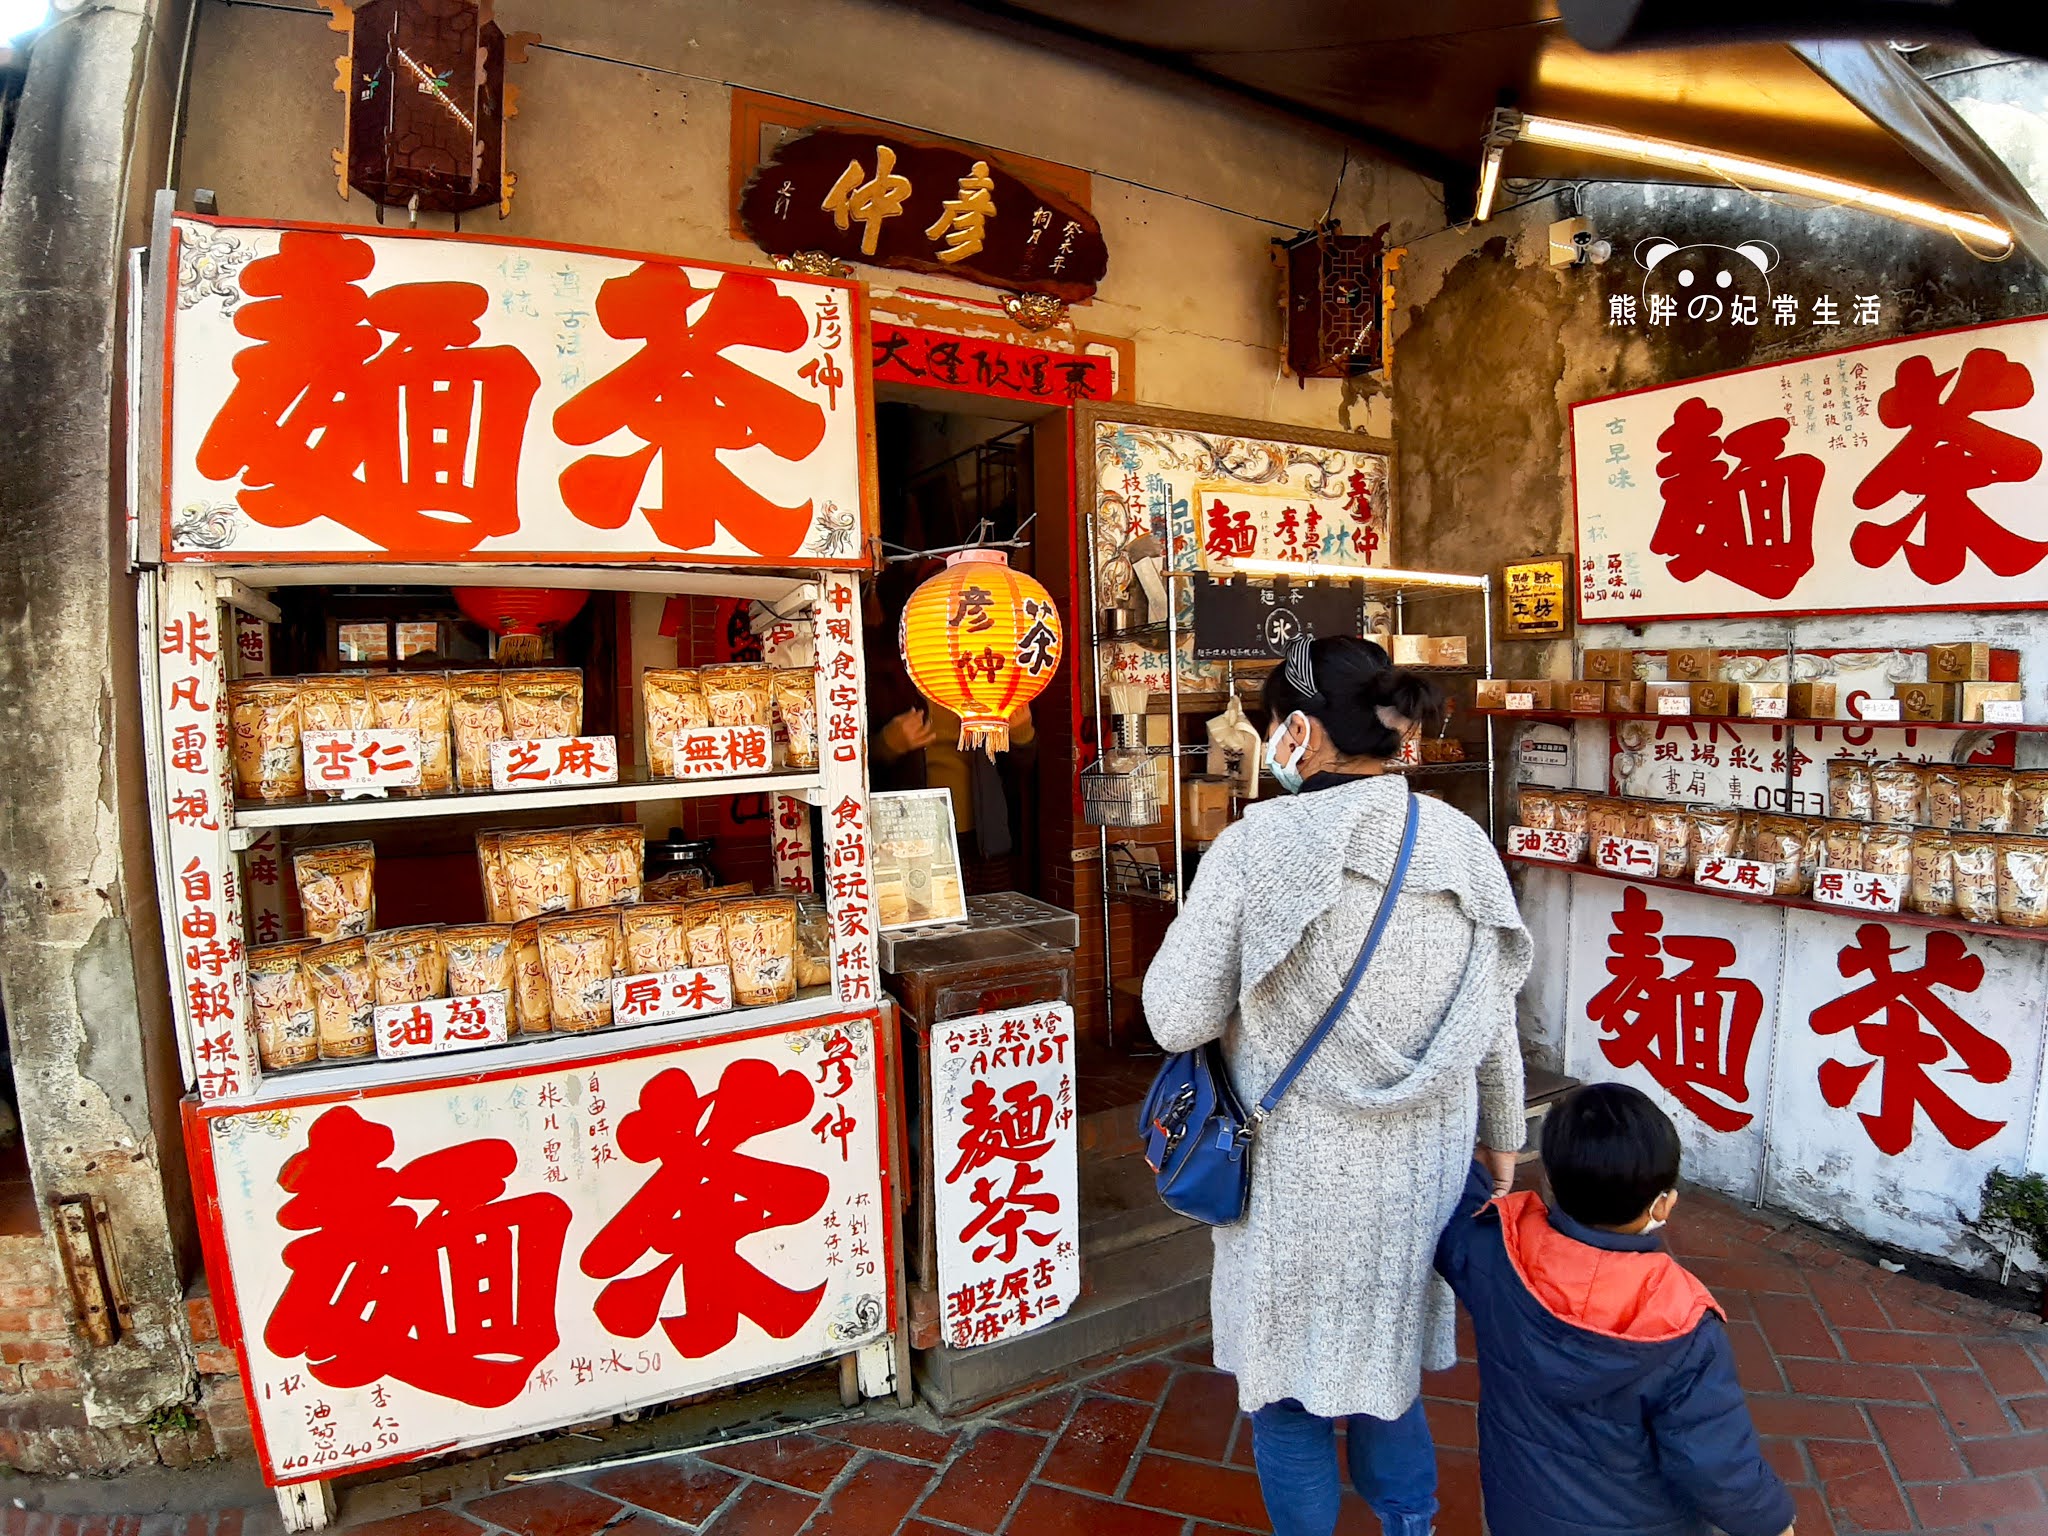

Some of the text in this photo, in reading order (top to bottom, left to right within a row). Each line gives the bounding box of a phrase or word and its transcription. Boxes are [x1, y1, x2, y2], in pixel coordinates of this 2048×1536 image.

[195, 231, 827, 558] 麵茶
[1604, 416, 1637, 490] 古早味
[1649, 347, 2048, 600] 麵茶
[1017, 599, 1058, 677] 茶
[824, 582, 860, 763] 中視食字路口
[160, 611, 220, 832] 非凡電視
[679, 727, 767, 774] 無糖
[312, 738, 415, 783] 杏仁
[506, 738, 611, 782] 芝麻
[1600, 838, 1652, 867] 杏仁
[1700, 857, 1769, 890] 芝麻
[831, 794, 872, 1003] 食尚玩家採訪
[1818, 873, 1895, 906] 原味
[619, 972, 727, 1017] 原味
[1586, 885, 2013, 1157] 麵茶
[969, 1033, 1070, 1076] ARTIST
[945, 1079, 1063, 1265] 麵茶
[263, 1058, 831, 1408] 麵茶
[996, 1267, 1037, 1327] 原味
[1032, 1257, 1060, 1316] 杏仁
[282, 1432, 399, 1471] 40 40 40 50
